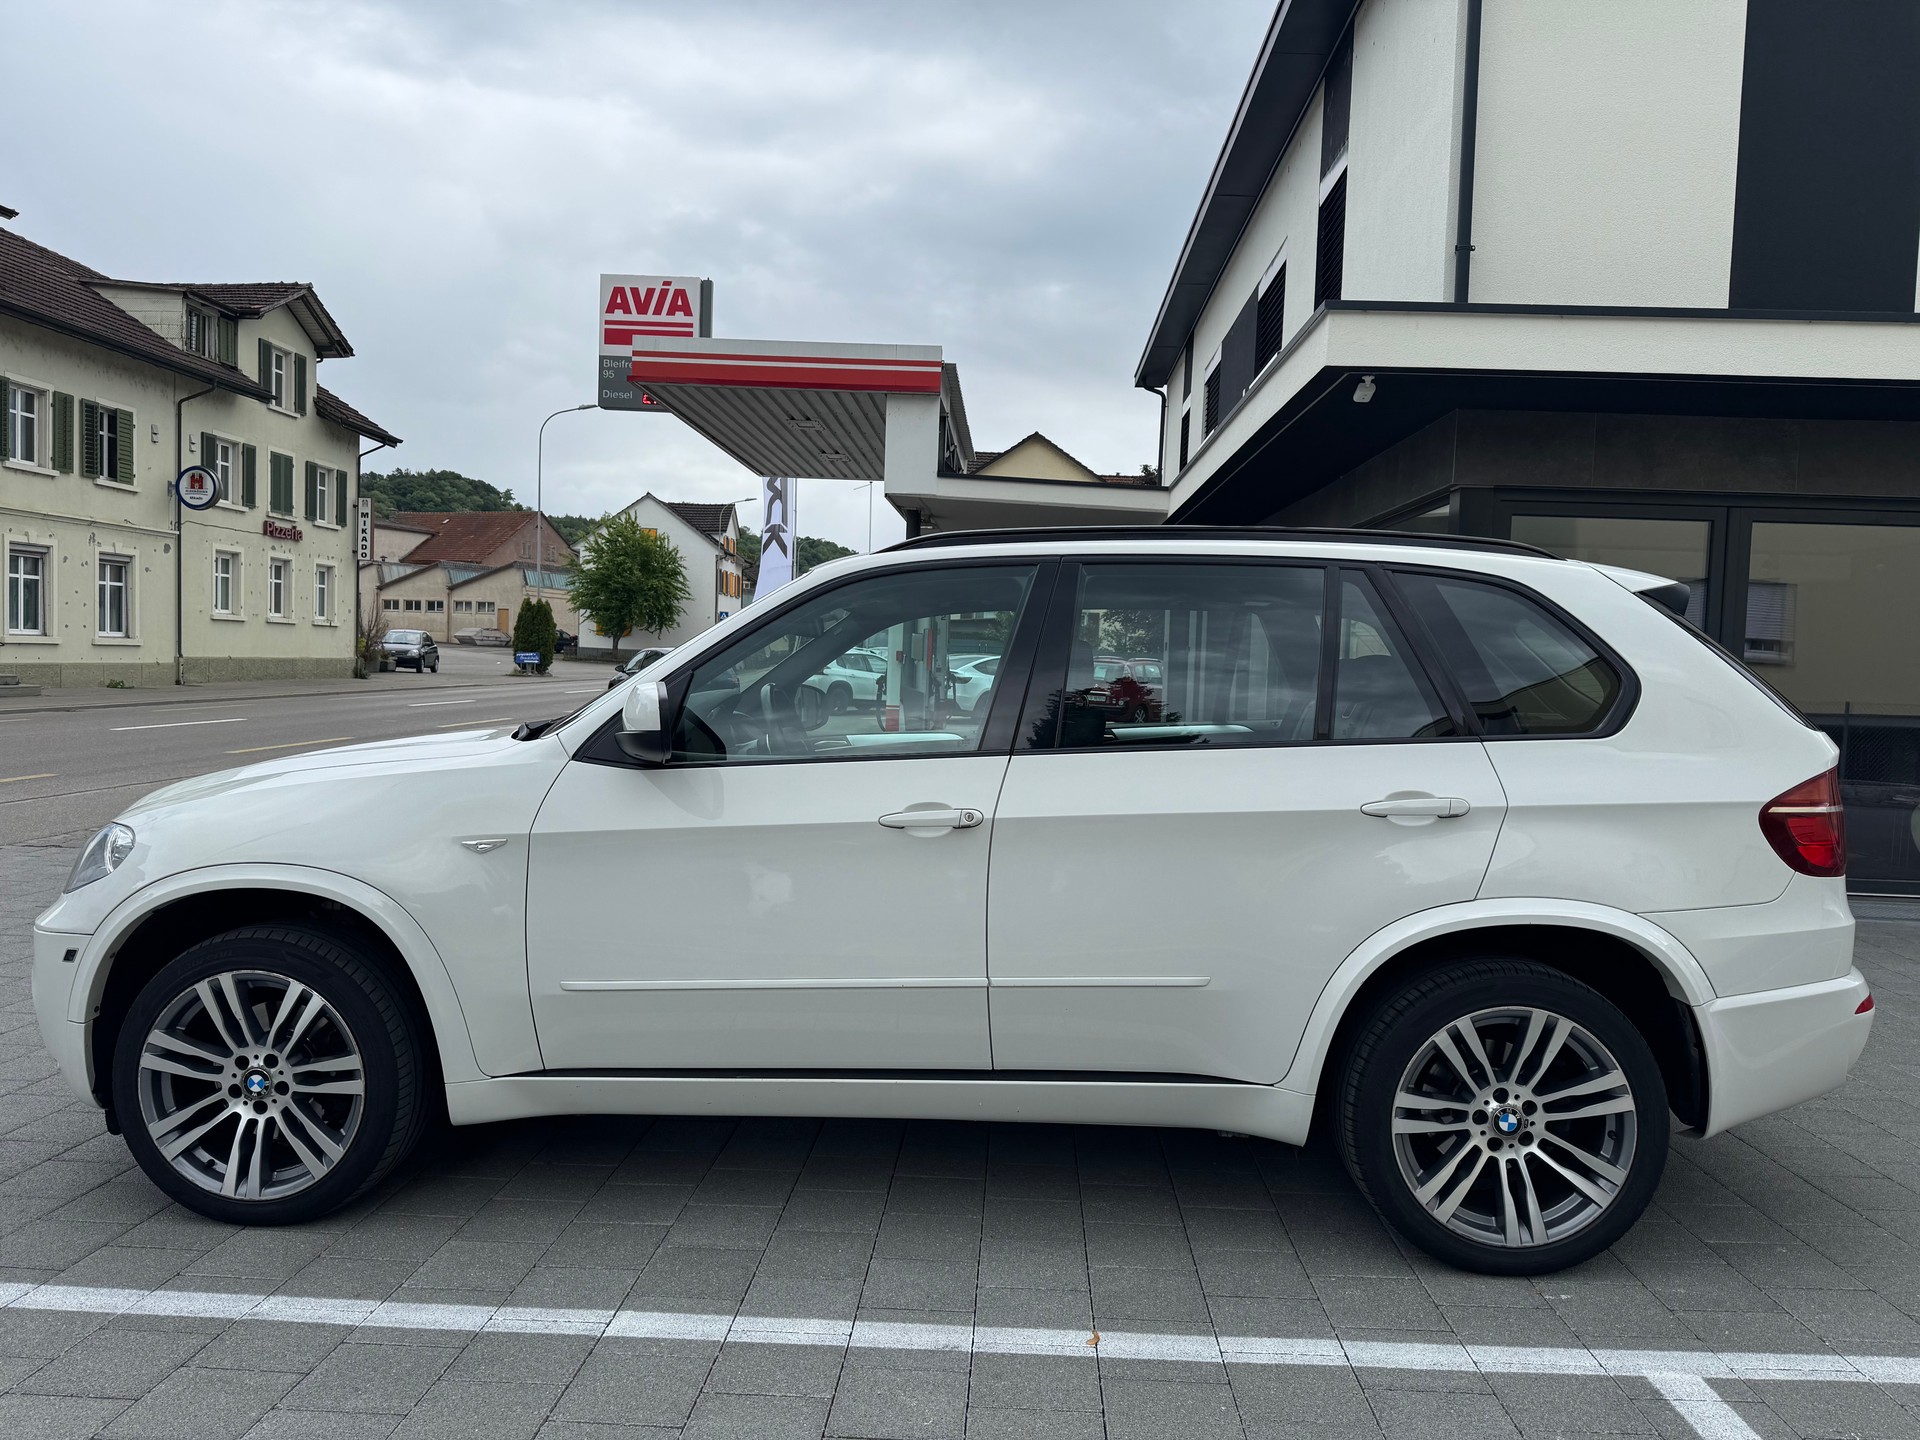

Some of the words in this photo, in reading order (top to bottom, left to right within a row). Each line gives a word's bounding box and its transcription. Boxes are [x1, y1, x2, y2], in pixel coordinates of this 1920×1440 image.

[602, 369, 615, 379] 95
[602, 389, 633, 399] Diesel
[265, 520, 304, 542] Pizzeria
[360, 511, 369, 559] MIKADO
